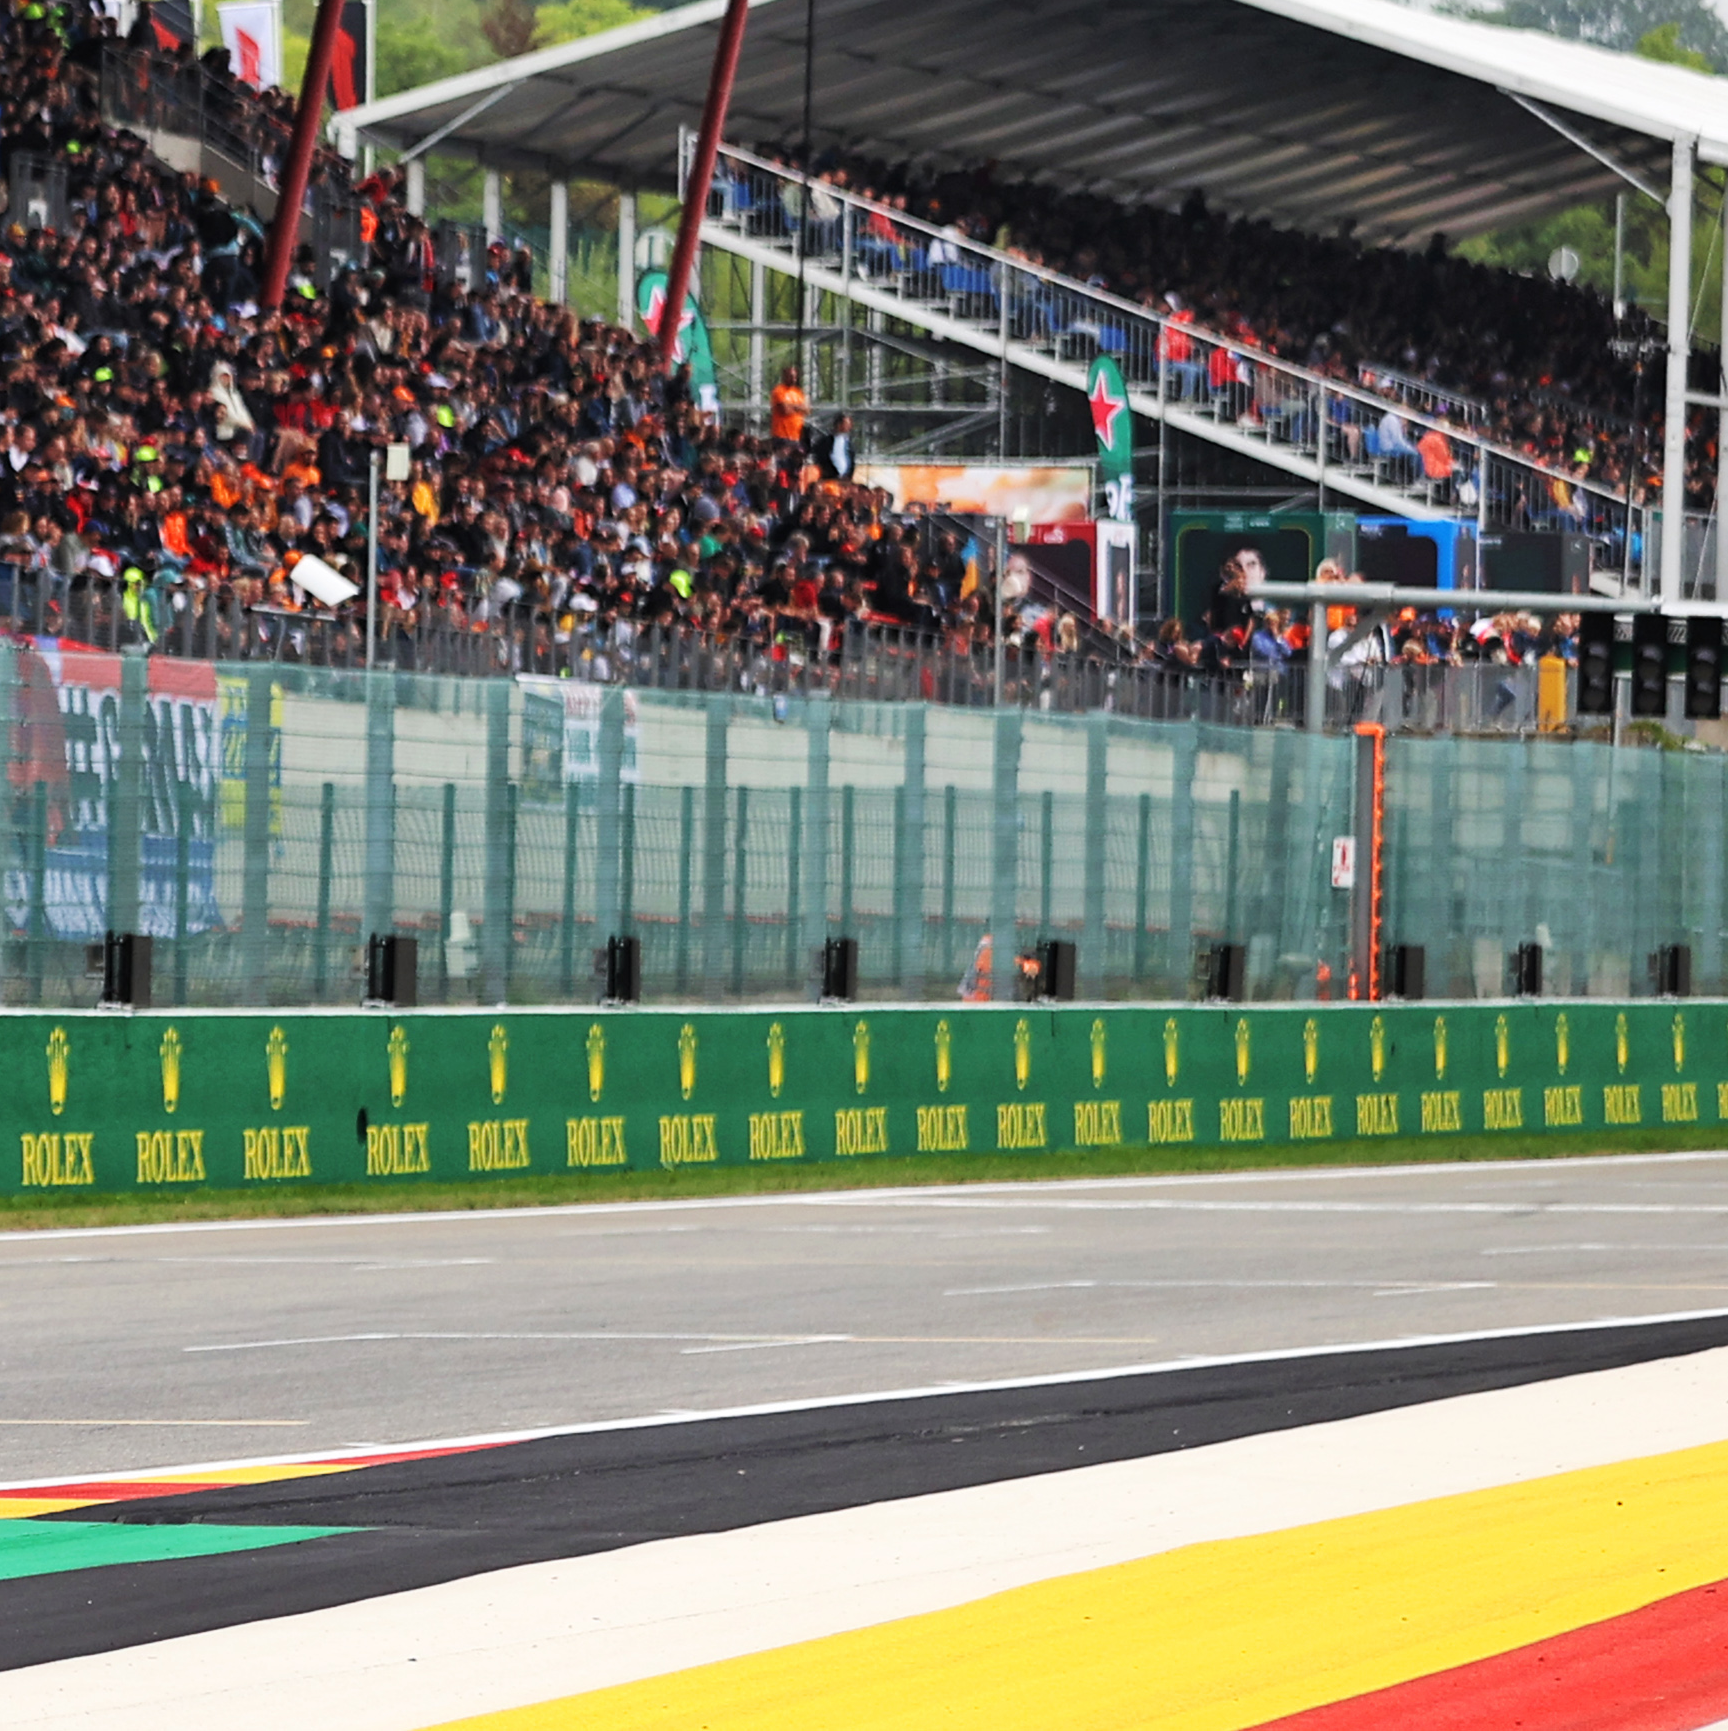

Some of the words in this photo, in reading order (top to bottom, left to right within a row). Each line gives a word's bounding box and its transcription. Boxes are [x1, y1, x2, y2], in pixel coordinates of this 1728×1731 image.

[567, 1117, 625, 1165] ROLEX
[660, 1115, 716, 1162] ROLEX
[750, 1112, 804, 1158] ROLEX
[836, 1108, 887, 1154] ROLEX
[917, 1106, 967, 1150] ROLEX
[998, 1104, 1045, 1147] ROLEX
[1075, 1102, 1121, 1144] ROLEX
[1149, 1100, 1193, 1142] ROLEX
[1221, 1100, 1263, 1139] ROLEX
[21, 1133, 93, 1185] ROLEX
[137, 1131, 205, 1182] ROLEX
[244, 1127, 310, 1178] ROLEX
[367, 1124, 429, 1174] ROLEX
[469, 1120, 529, 1170] ROLEX
